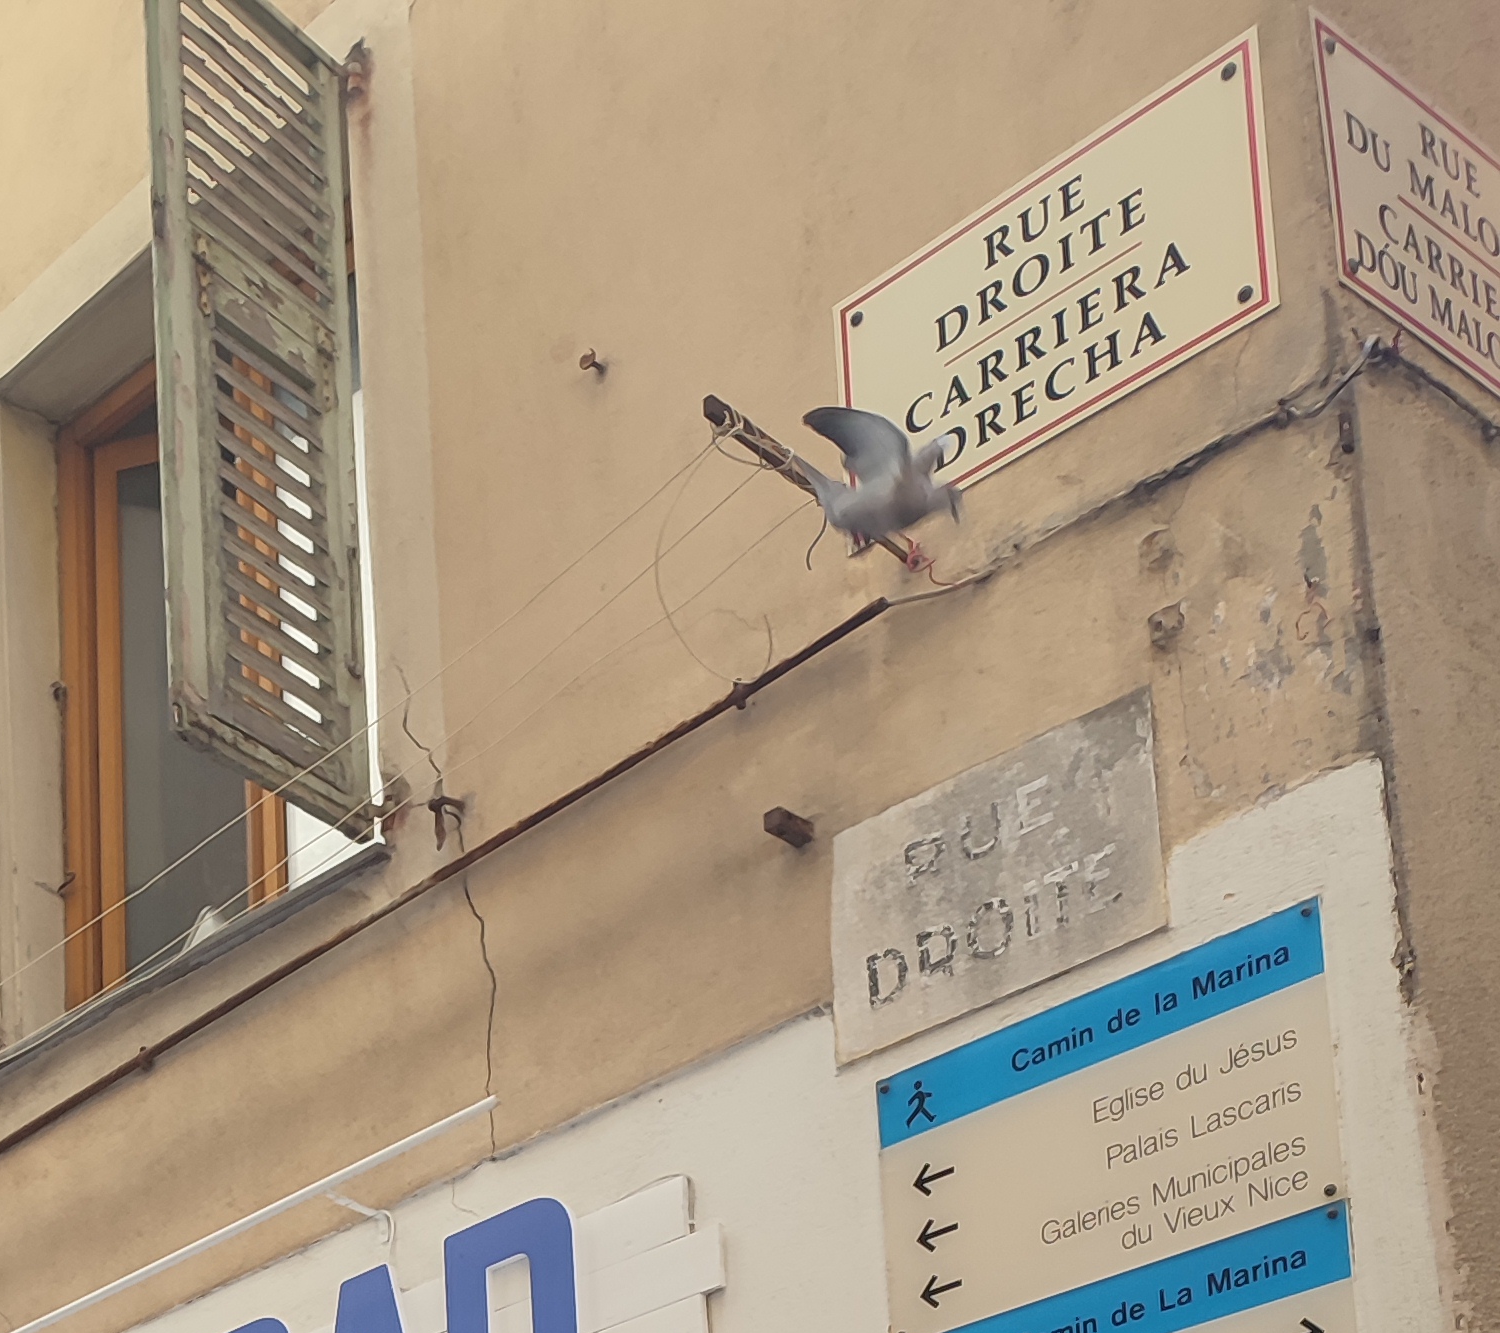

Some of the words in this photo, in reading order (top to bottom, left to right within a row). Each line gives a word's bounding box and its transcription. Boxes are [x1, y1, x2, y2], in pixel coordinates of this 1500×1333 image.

[1344, 109, 1391, 173] DU
[1418, 120, 1481, 199] RUE
[934, 187, 1147, 353] DROITE
[983, 174, 1086, 271] RUE
[904, 242, 1191, 434] CARRIERA
[934, 311, 1167, 474] DRECHA
[904, 775, 1053, 889] RUE
[866, 843, 1123, 1008] DROITE
[1011, 1026, 1095, 1073] Camin
[1107, 1004, 1141, 1034] de
[1154, 989, 1178, 1016] la
[1193, 945, 1290, 1000] Marina
[1093, 1079, 1165, 1125] Eglise
[1176, 1060, 1208, 1091] du
[1218, 1028, 1298, 1081] Jésus
[1106, 1125, 1179, 1169] Palais
[1190, 1082, 1302, 1139] Lascaris
[1040, 1197, 1140, 1245] Galeries
[1153, 1135, 1306, 1208] Municipales
[1121, 1223, 1153, 1249] du
[1164, 1196, 1236, 1237] Vieux
[1248, 1168, 1308, 1207] Nice
[1111, 1299, 1145, 1328] de
[1160, 1283, 1192, 1312] La
[1207, 1249, 1307, 1297] Marina
